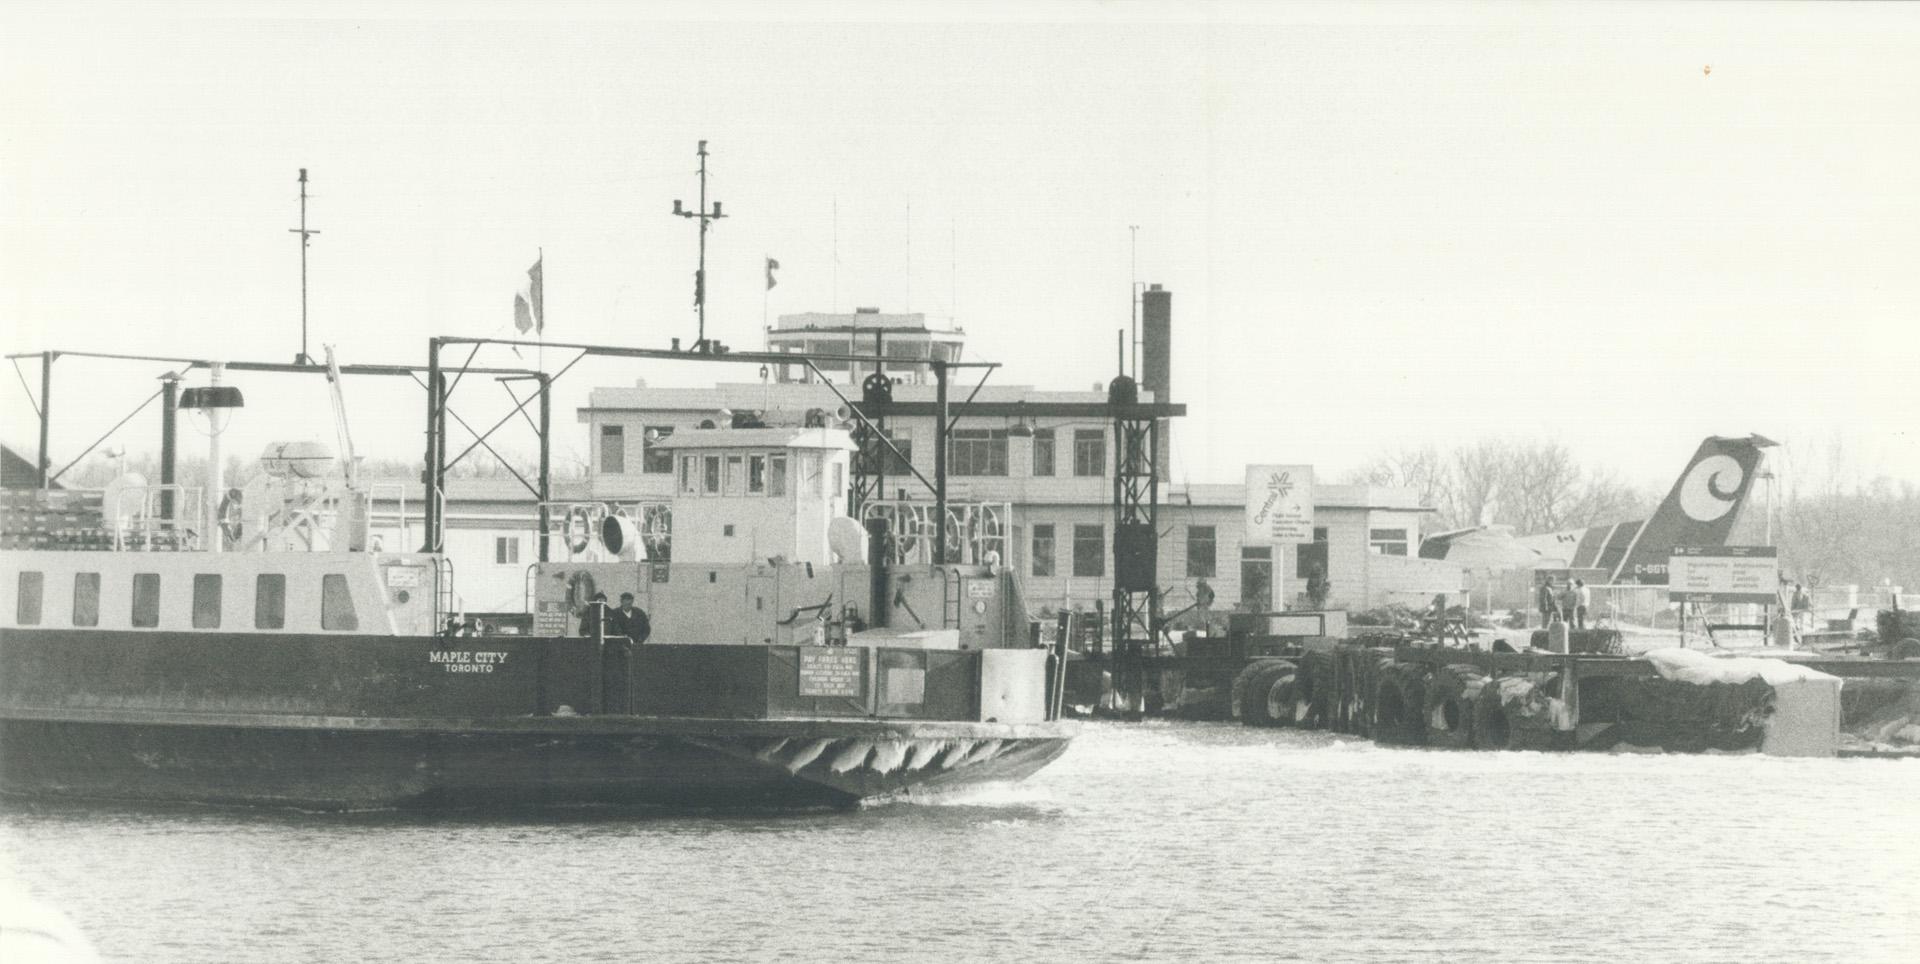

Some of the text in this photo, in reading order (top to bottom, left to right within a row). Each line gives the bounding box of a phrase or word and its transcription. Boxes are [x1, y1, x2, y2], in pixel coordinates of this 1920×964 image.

[1254, 490, 1278, 525] Central
[429, 651, 508, 663] MAPLE CITY
[445, 664, 494, 673] TORONTO
